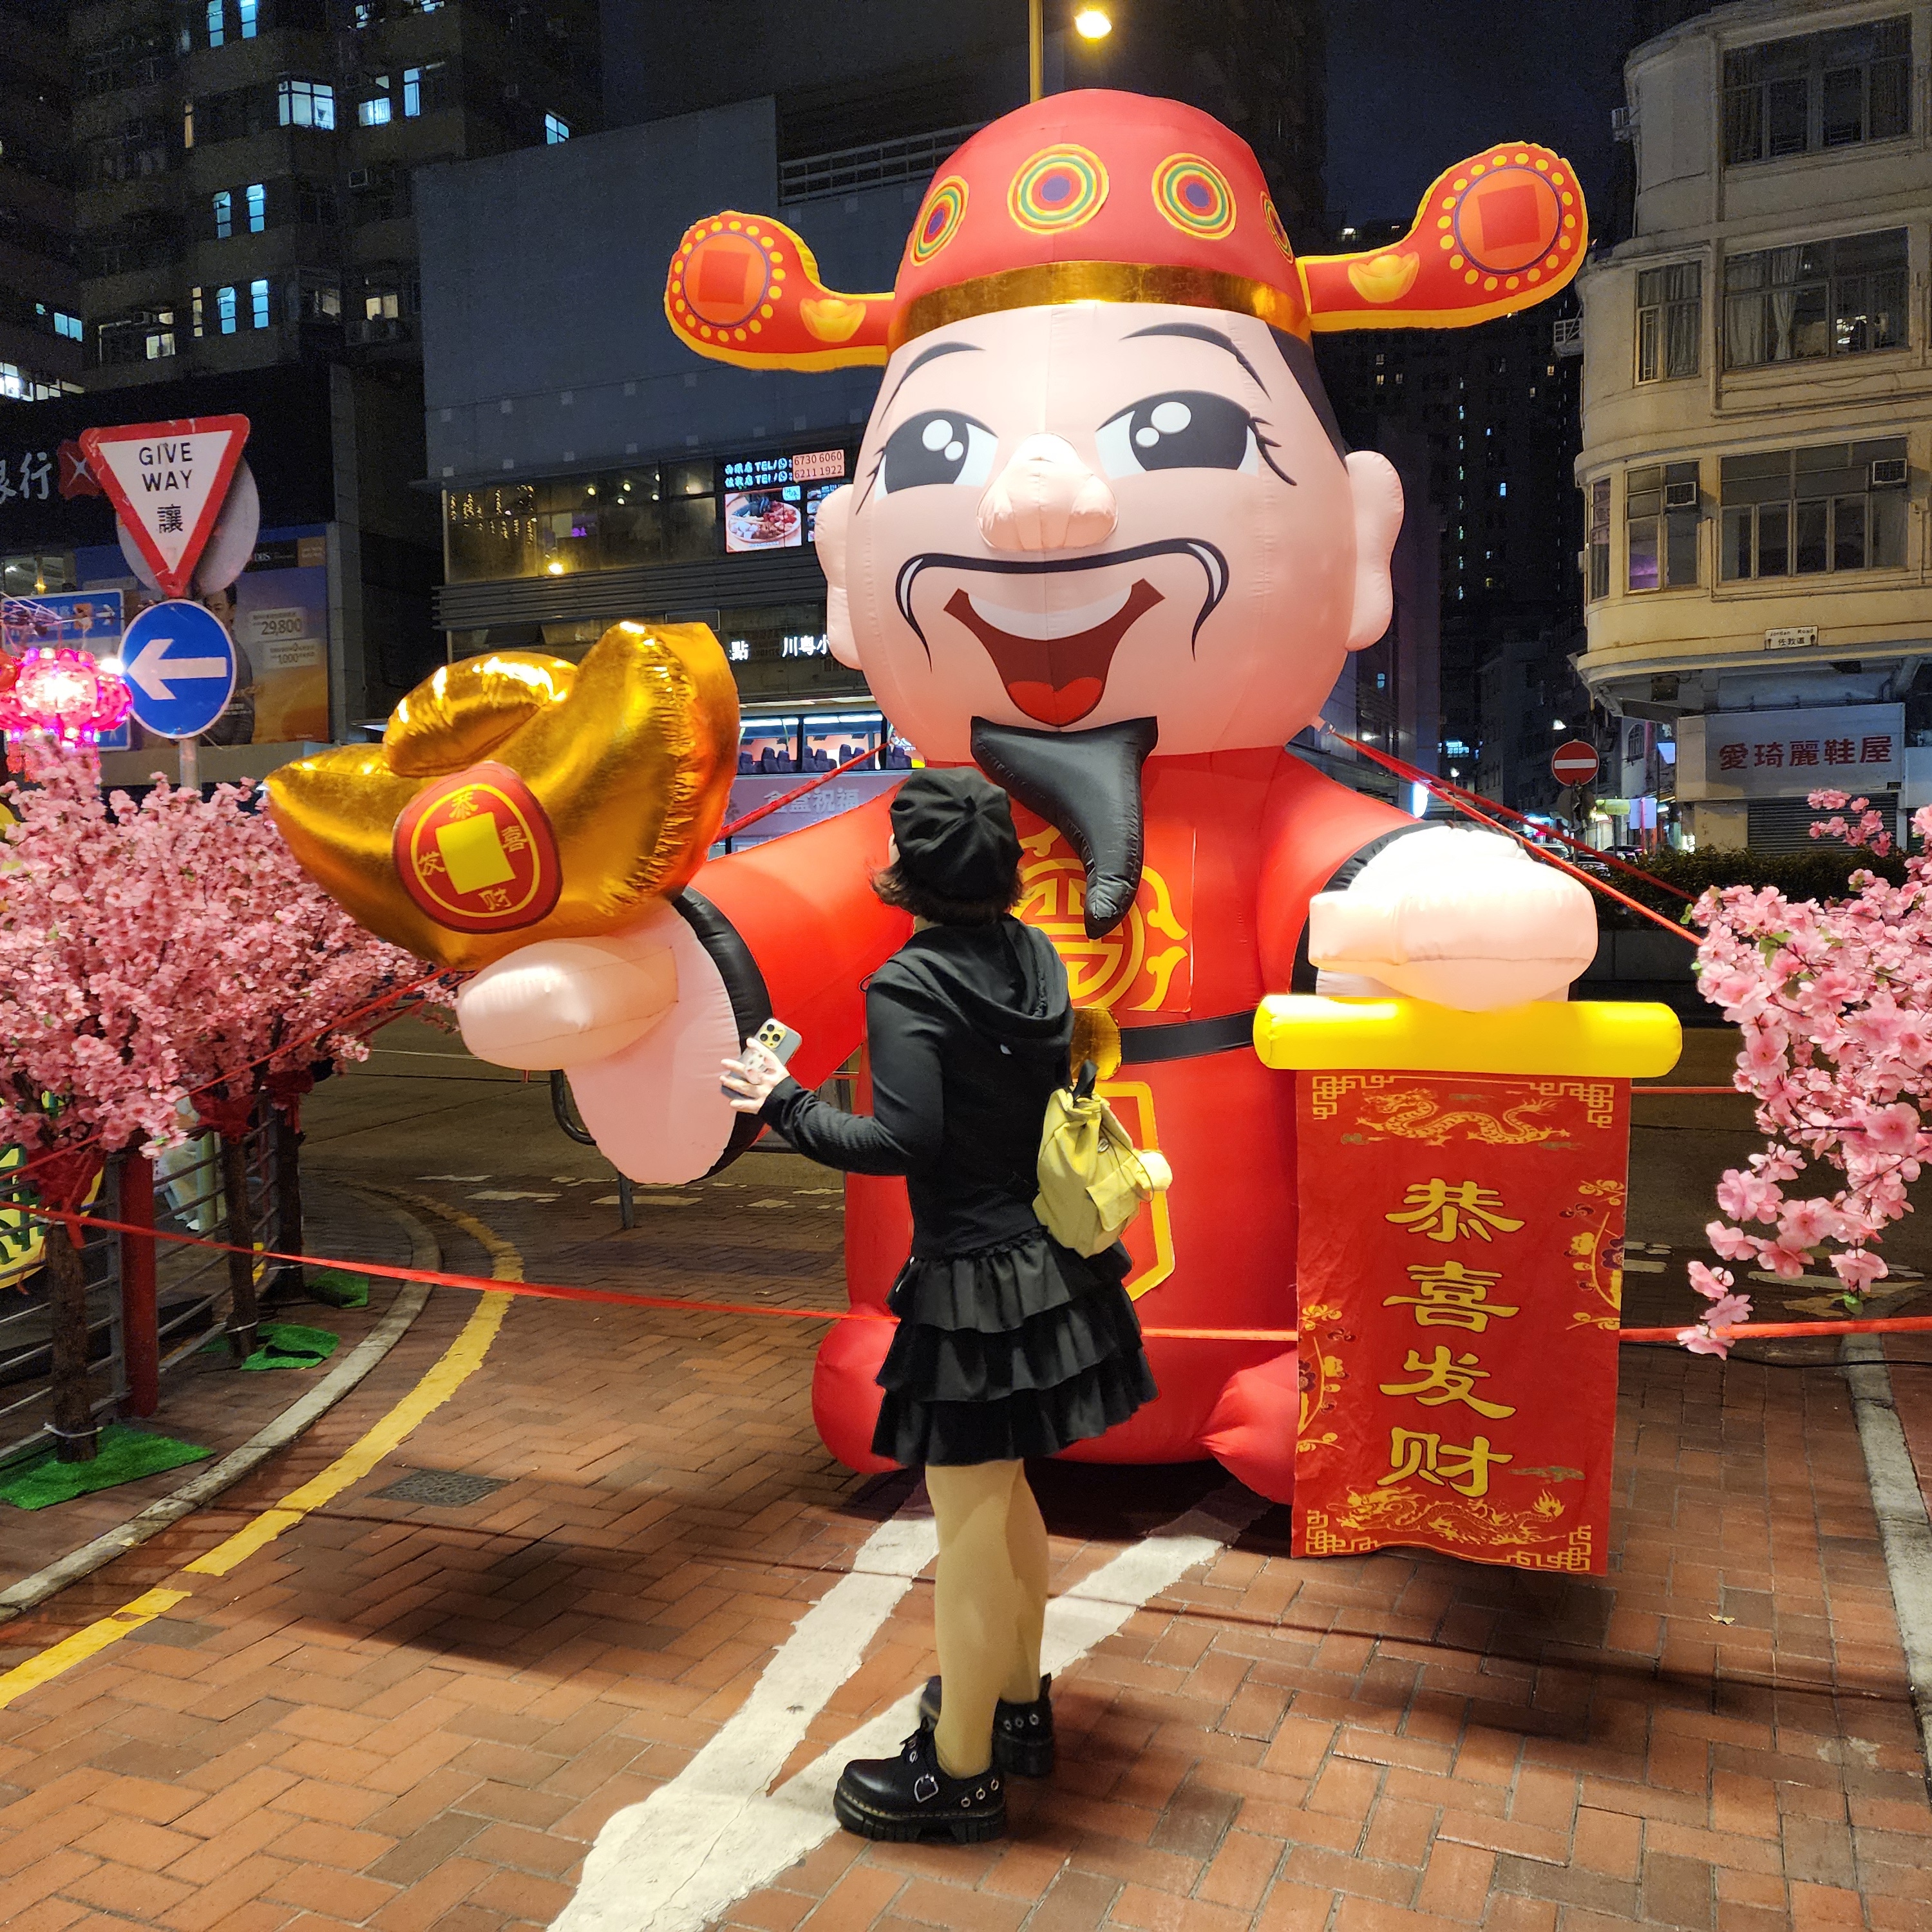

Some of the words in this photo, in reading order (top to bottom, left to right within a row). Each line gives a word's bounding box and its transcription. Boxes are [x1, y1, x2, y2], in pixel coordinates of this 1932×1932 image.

[139, 442, 193, 466] GIVE
[795, 455, 817, 466] 6730
[819, 451, 842, 462] 6060
[142, 469, 192, 492] WAY
[795, 468, 817, 479] 6211
[820, 465, 842, 476] 1922
[157, 504, 184, 533] 讓
[729, 640, 749, 661] 點
[1719, 735, 1892, 771] 愛琦麗鞋屋
[502, 825, 528, 852] 喜
[478, 888, 512, 911] 财
[1377, 1178, 1526, 1497] 恭喜发财
